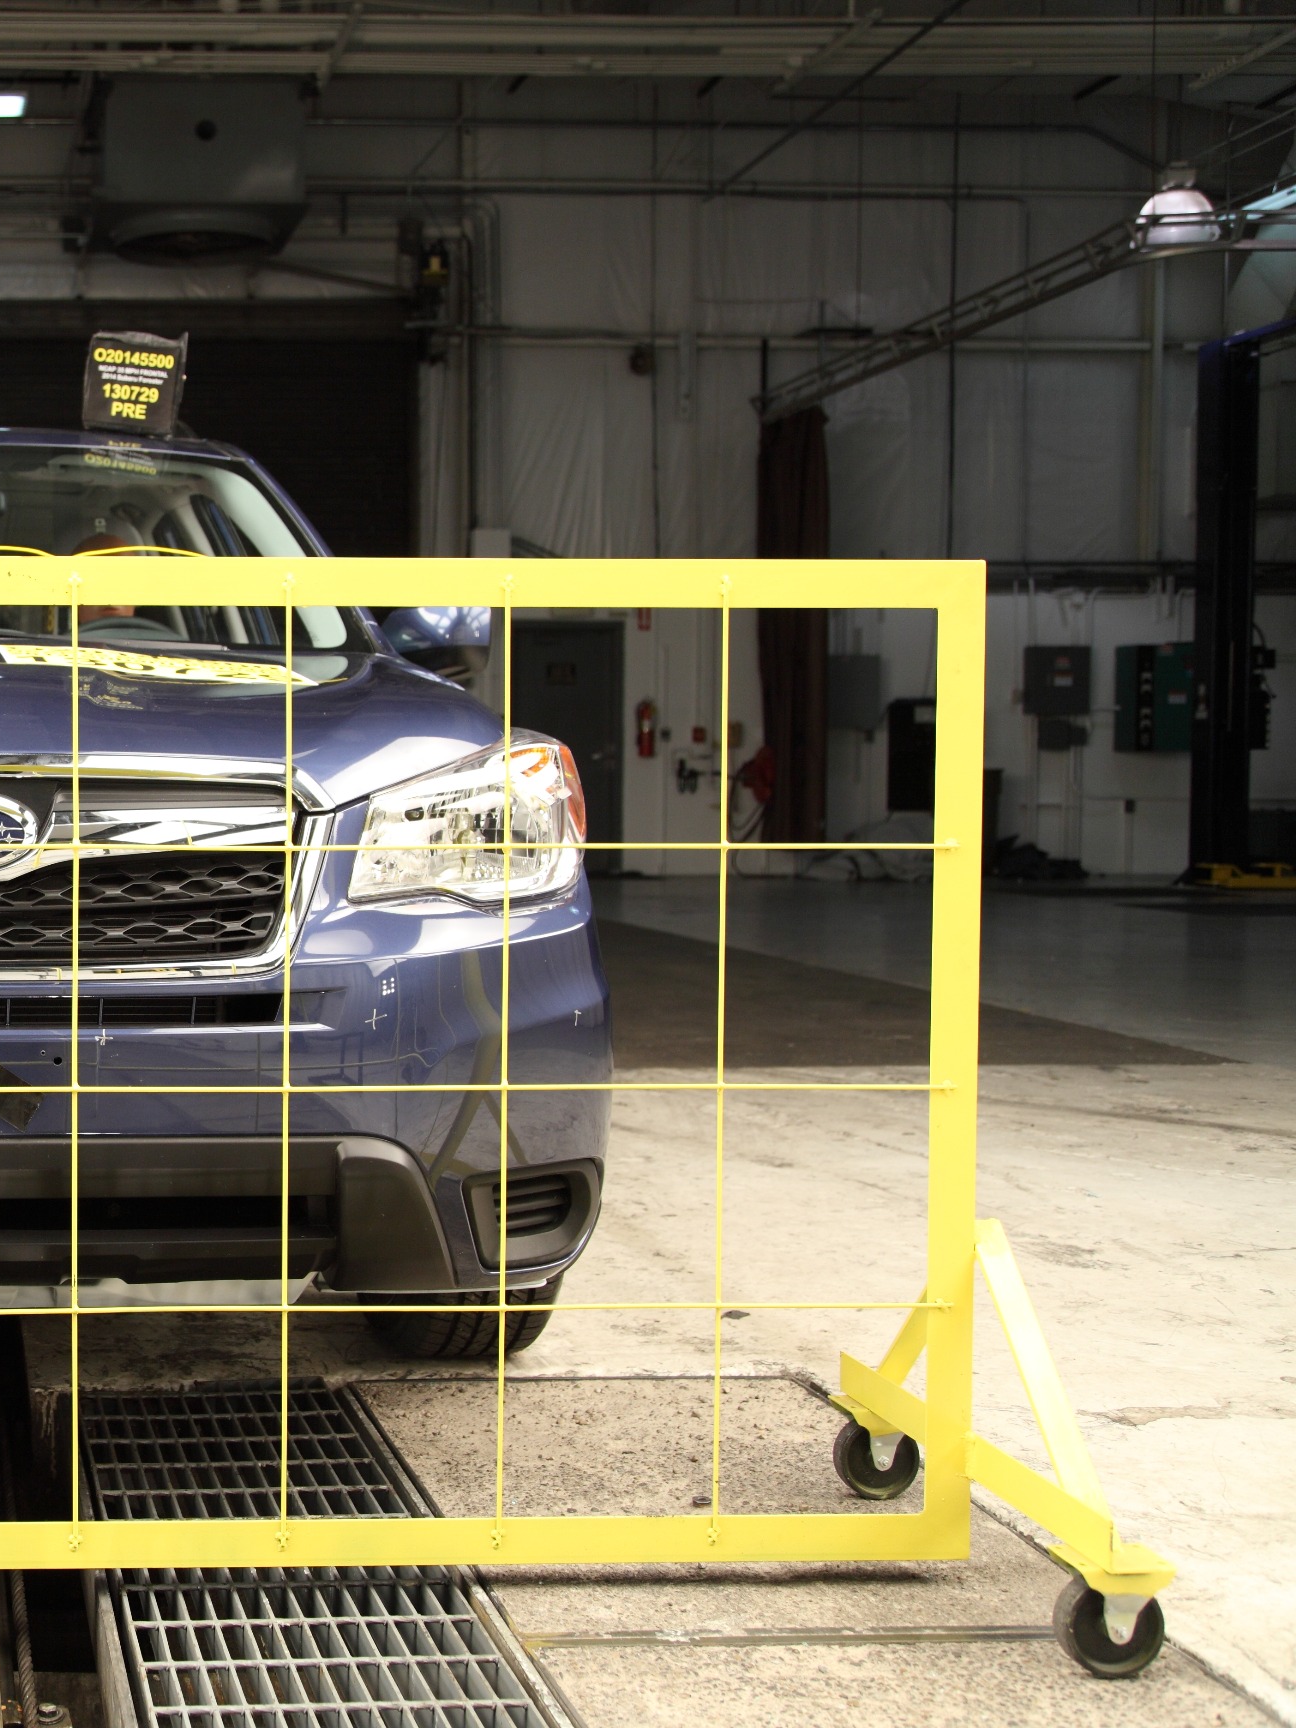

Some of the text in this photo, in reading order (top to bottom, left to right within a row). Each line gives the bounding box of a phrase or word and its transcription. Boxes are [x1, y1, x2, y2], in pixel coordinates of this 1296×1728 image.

[93, 348, 175, 369] O20145500
[103, 383, 159, 403] 130729
[111, 402, 147, 419] PRE
